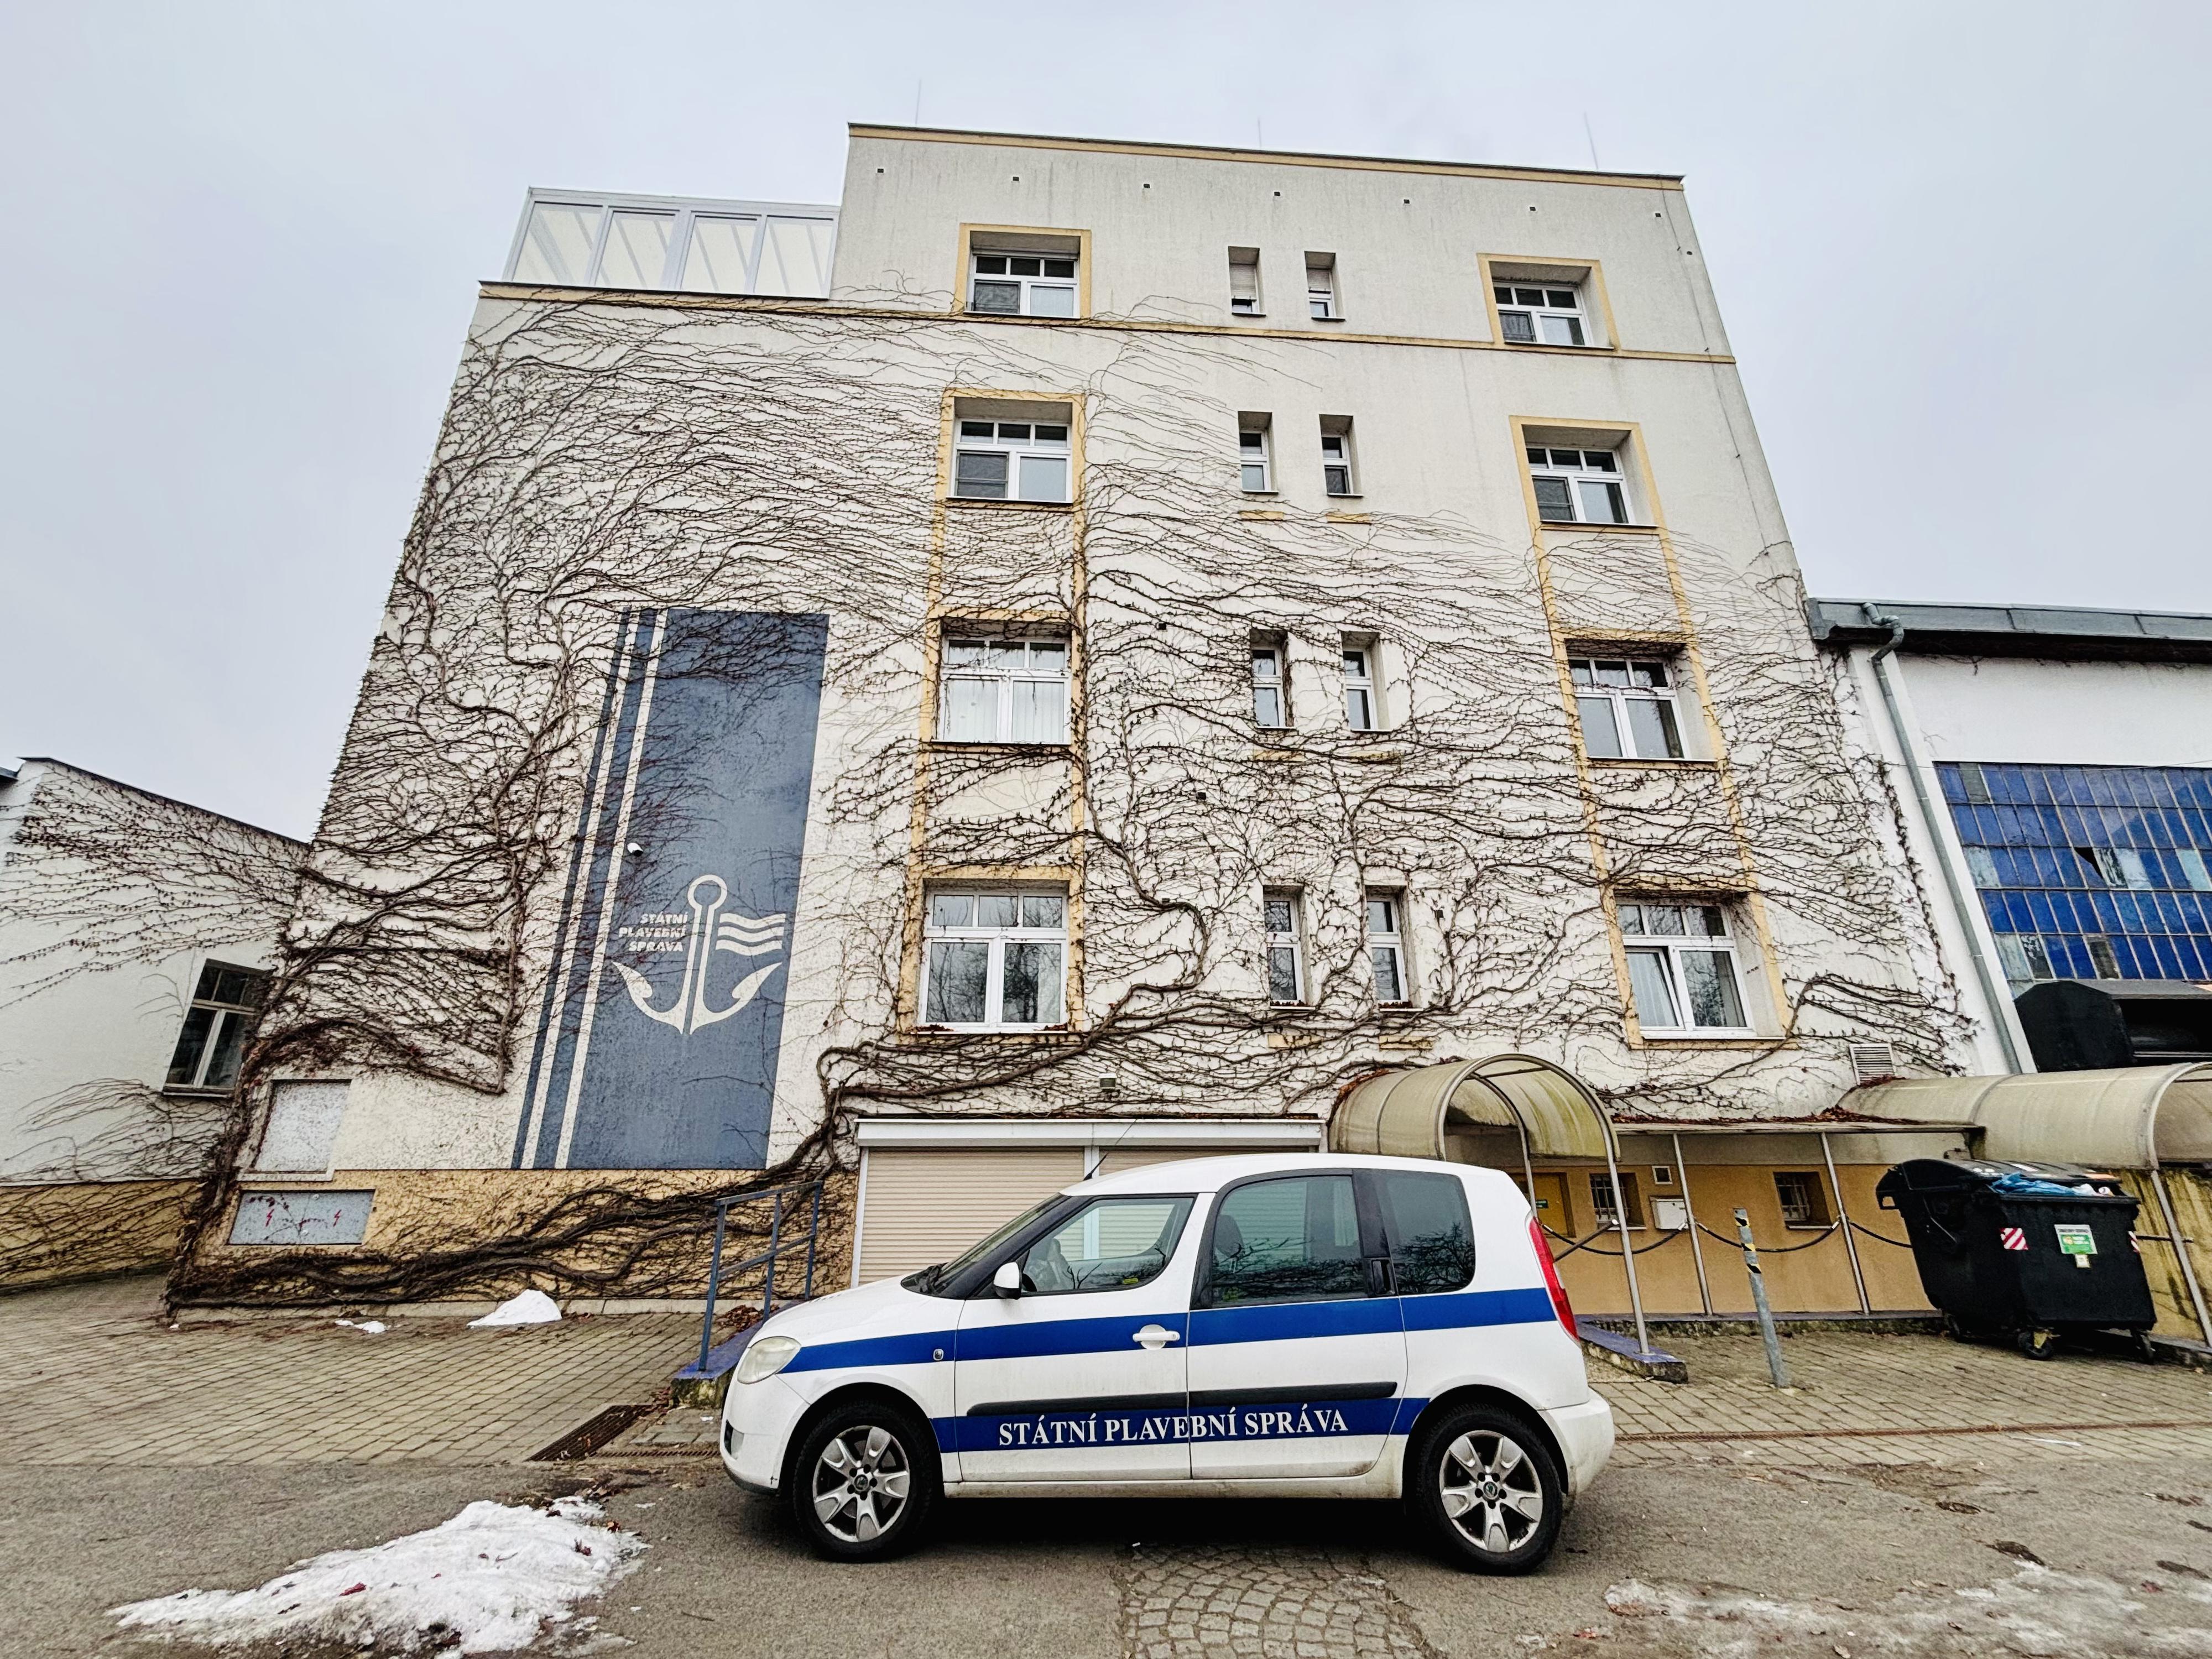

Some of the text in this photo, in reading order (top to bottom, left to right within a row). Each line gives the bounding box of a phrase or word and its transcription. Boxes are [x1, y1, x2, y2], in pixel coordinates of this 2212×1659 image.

[640, 911, 688, 924] STÁTNÍ
[618, 925, 686, 938] PLAVEBNÍ
[999, 1403, 1348, 1446] STÁTNÍ PLAVEBNÍ SPRÁVA
